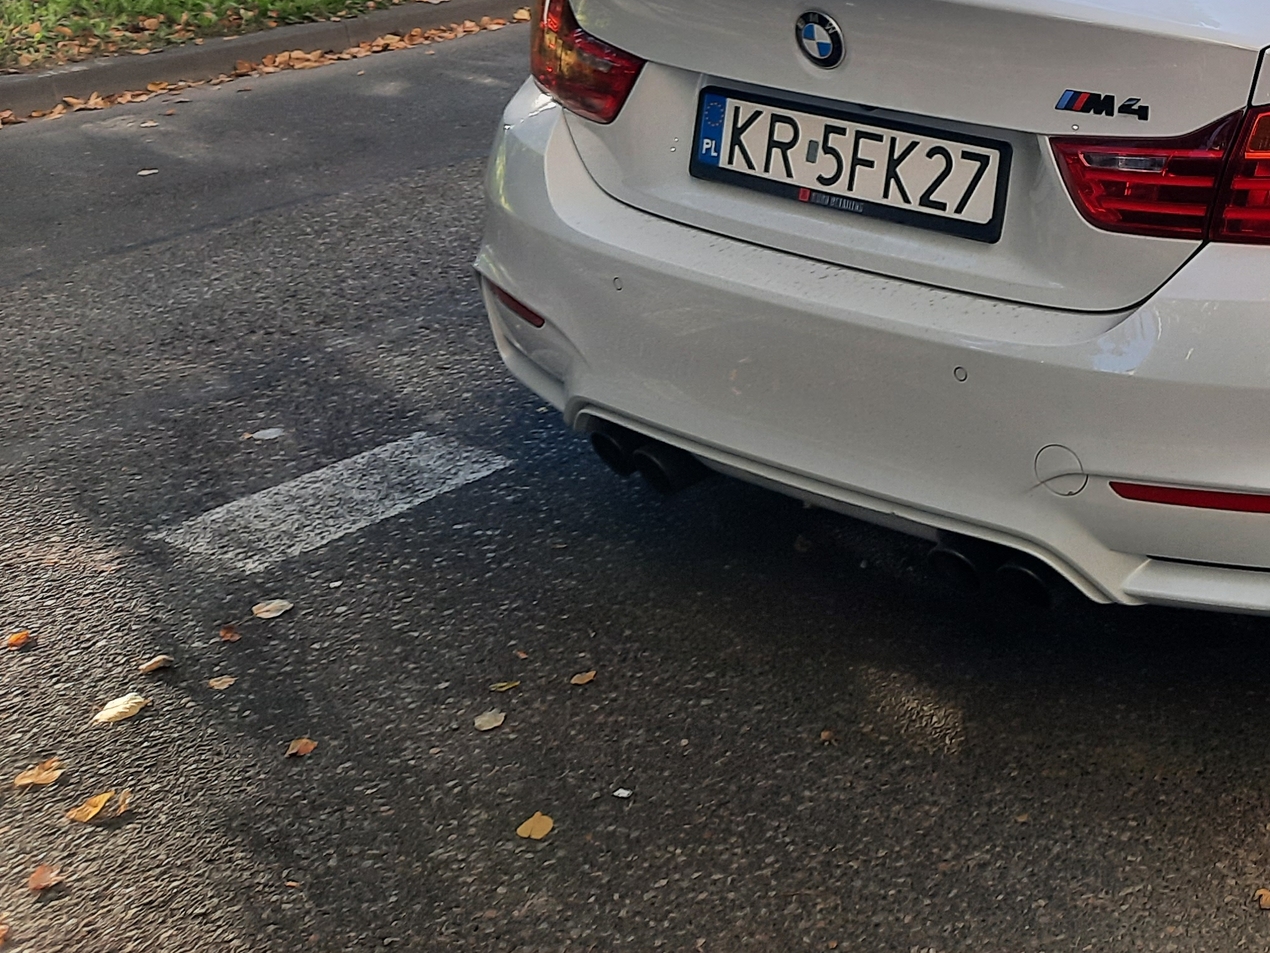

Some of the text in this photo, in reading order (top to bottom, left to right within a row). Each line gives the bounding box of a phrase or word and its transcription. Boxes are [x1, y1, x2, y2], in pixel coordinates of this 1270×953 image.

[797, 13, 837, 34] BMW
[1078, 91, 1150, 121] M4
[701, 138, 719, 157] PL
[727, 105, 991, 215] KR 5FK27
